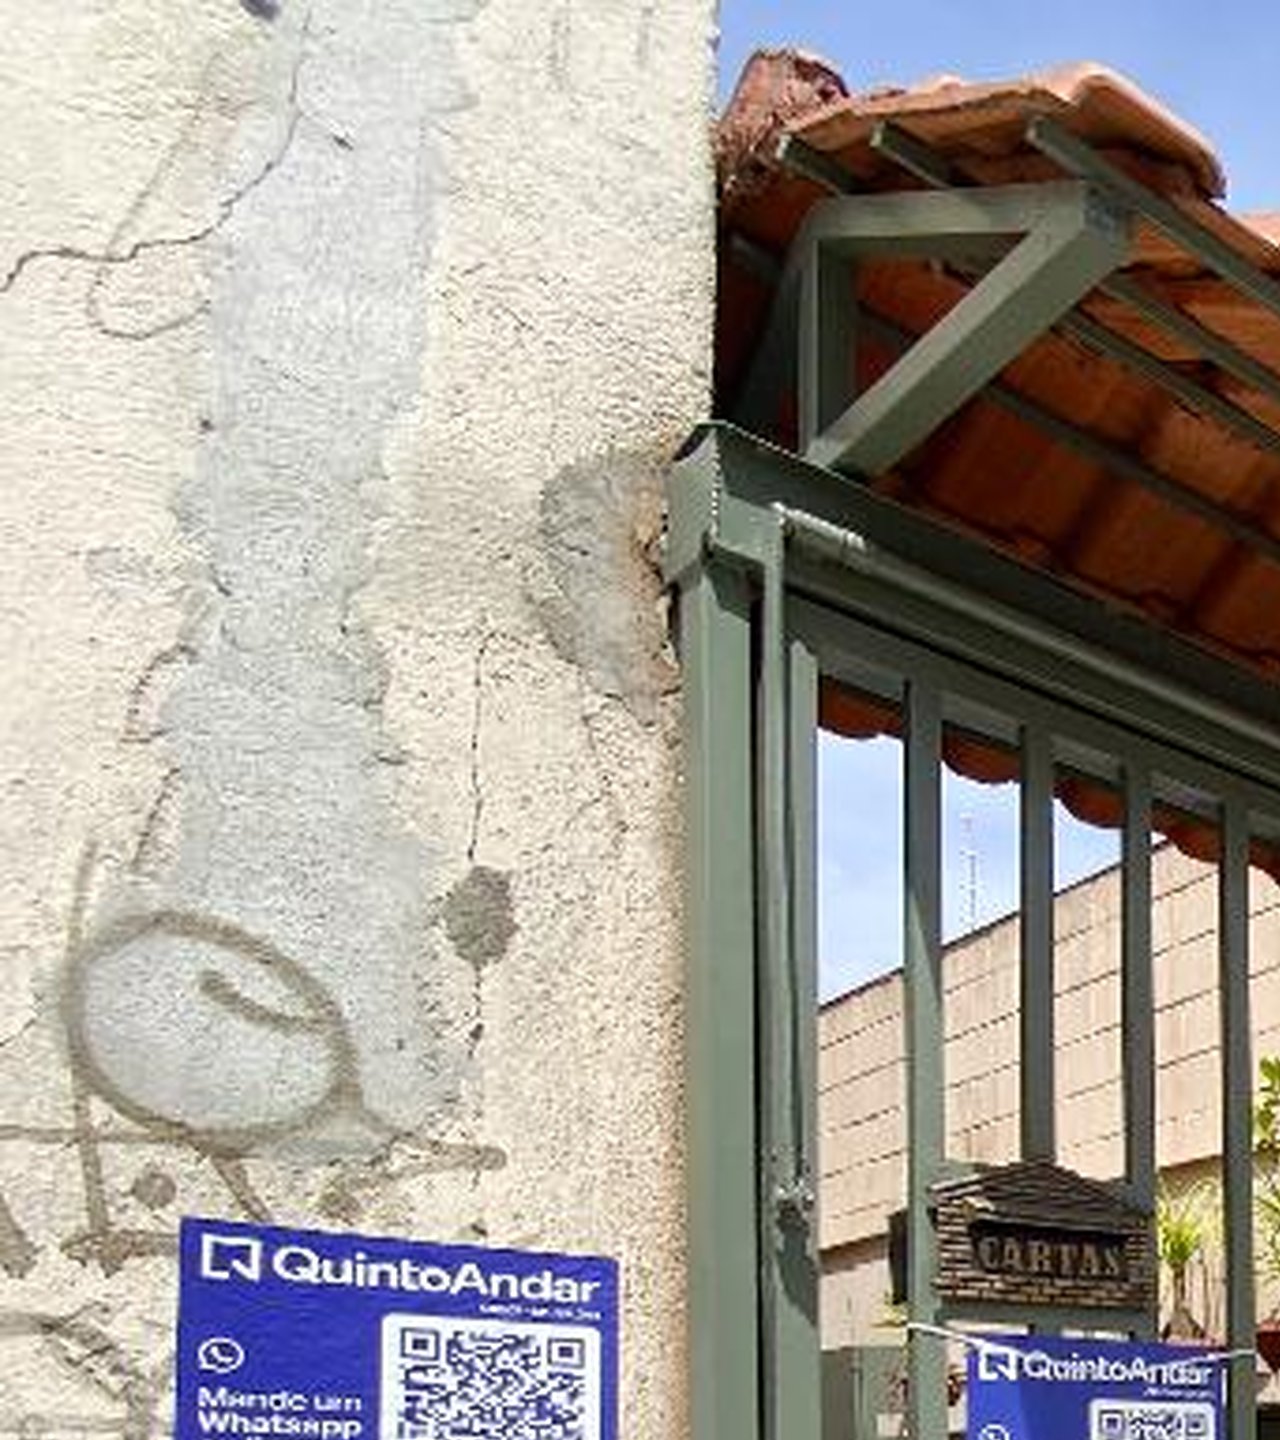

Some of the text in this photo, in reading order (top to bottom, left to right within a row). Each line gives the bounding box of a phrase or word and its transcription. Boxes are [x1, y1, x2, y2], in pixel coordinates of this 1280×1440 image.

[979, 1234, 1121, 1278] CARTAS
[272, 1246, 602, 1304] QuintoAndar
[1022, 1349, 1213, 1386] QuintoAndar
[313, 1394, 363, 1412] um
[197, 1410, 363, 1440] Whatsapp
